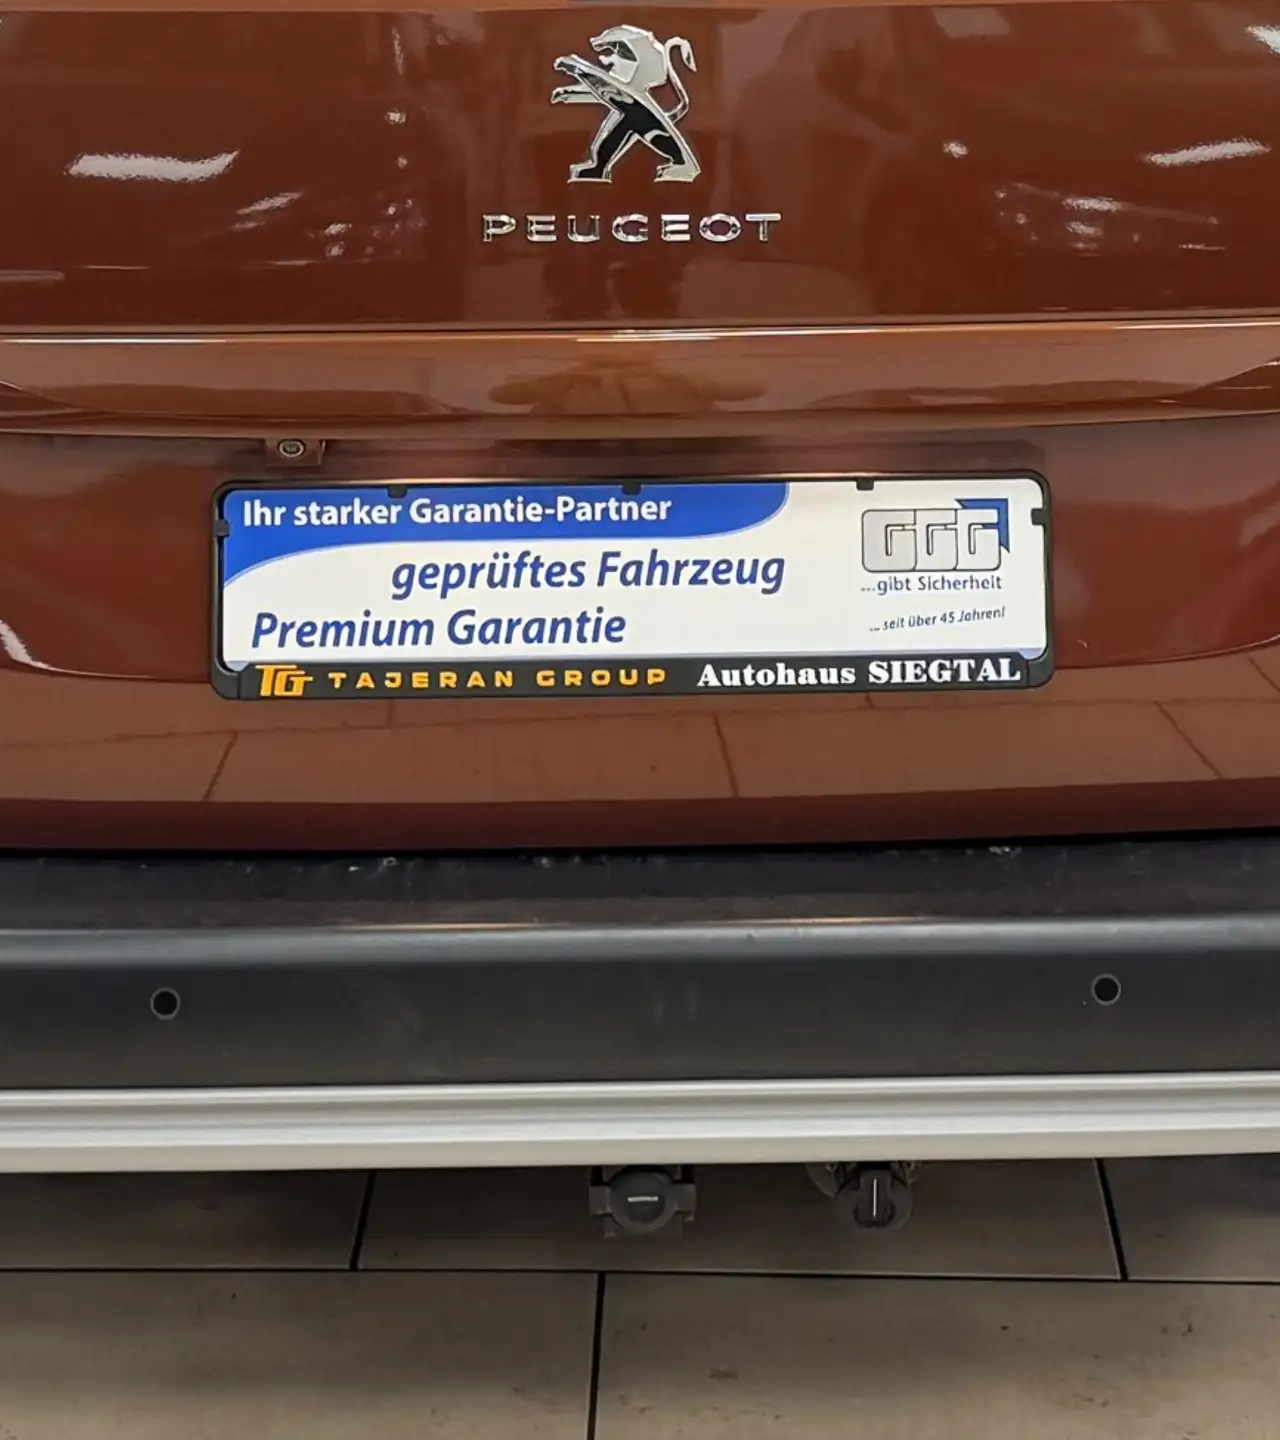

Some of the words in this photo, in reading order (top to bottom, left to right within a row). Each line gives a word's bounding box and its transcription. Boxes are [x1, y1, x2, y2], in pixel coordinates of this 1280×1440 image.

[482, 212, 782, 243] PEUGEOT
[243, 499, 286, 526] Ihr
[293, 497, 401, 526] starker
[409, 495, 672, 524] Garantie-Partner
[391, 549, 587, 601] geprüftes
[596, 548, 786, 595] Fahrzeug
[918, 574, 1002, 591] Sicherheit
[251, 609, 435, 648] Premium
[447, 606, 626, 646] Garantie
[908, 613, 936, 628] über
[940, 610, 955, 624] 45
[958, 606, 1006, 623] Jahren!
[328, 670, 513, 688] TAJERAN
[536, 668, 667, 687] GROUP
[697, 662, 856, 687] Autohaus
[868, 658, 1021, 684] SIEGTAL
